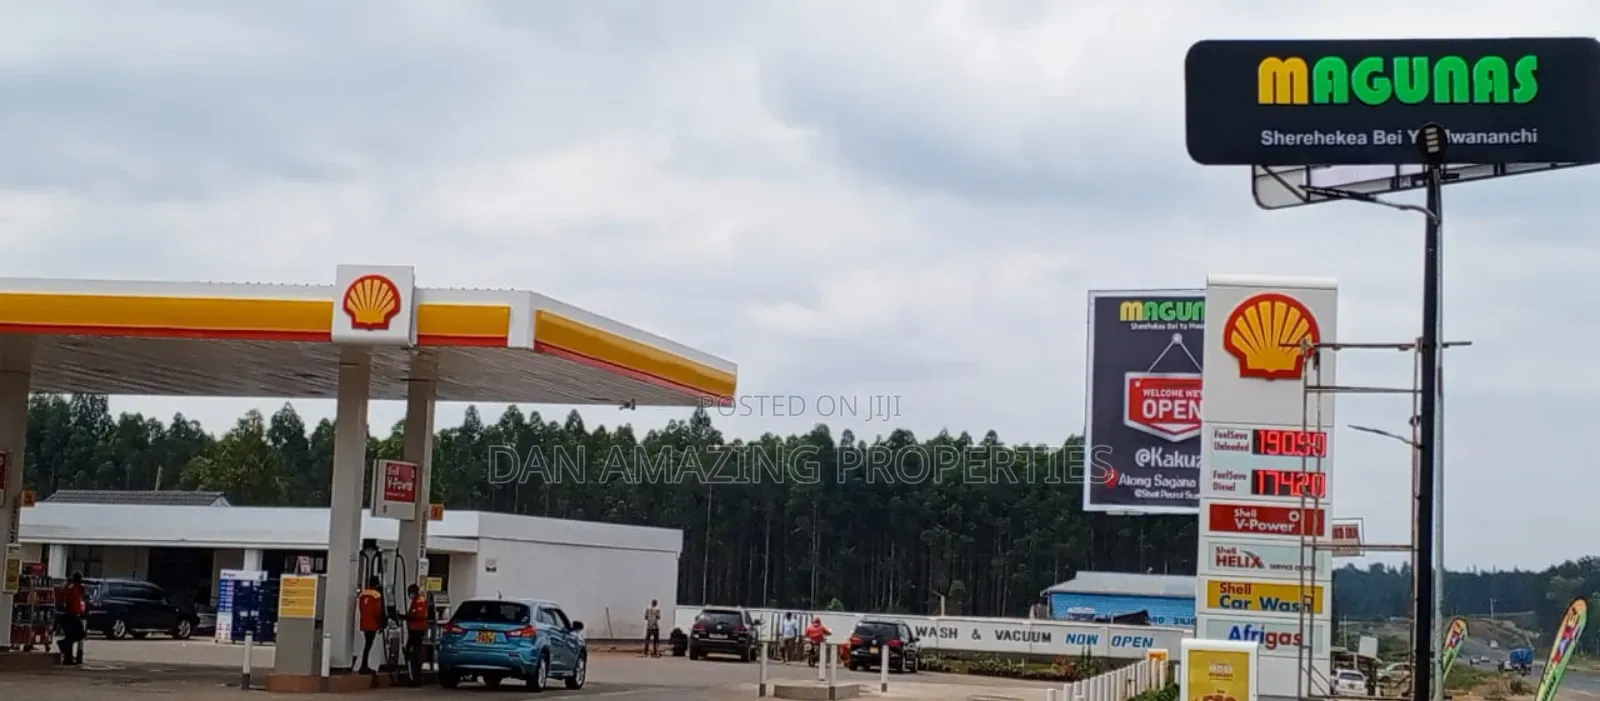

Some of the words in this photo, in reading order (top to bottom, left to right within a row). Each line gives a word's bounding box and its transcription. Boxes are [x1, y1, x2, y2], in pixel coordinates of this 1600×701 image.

[1258, 55, 1539, 105] MAGUNAS
[1261, 129, 1367, 147] Sherehekea
[1373, 129, 1402, 146] Bei
[1142, 389, 1184, 397] WELCOME
[1142, 399, 1203, 420] OPEN
[1214, 429, 1248, 440] FuelSave
[1214, 440, 1249, 452] Unleaded
[1118, 473, 1151, 488] Along
[1154, 474, 1196, 488] Sagana
[1213, 469, 1247, 480] FuelSave
[1213, 481, 1236, 491] Diesel
[1234, 508, 1257, 518] Shell
[1234, 518, 1295, 532] V-Power
[1215, 546, 1237, 554] Shell
[1215, 554, 1264, 569] HELIX
[1220, 582, 1252, 595] Shell
[1219, 594, 1252, 610] Car
[915, 626, 958, 639] WASH
[971, 629, 981, 640] &
[994, 630, 1052, 643] VACUUM
[1065, 633, 1099, 645] NOW
[1111, 635, 1154, 647] OPEN
[1228, 624, 1303, 650] Afrigas
